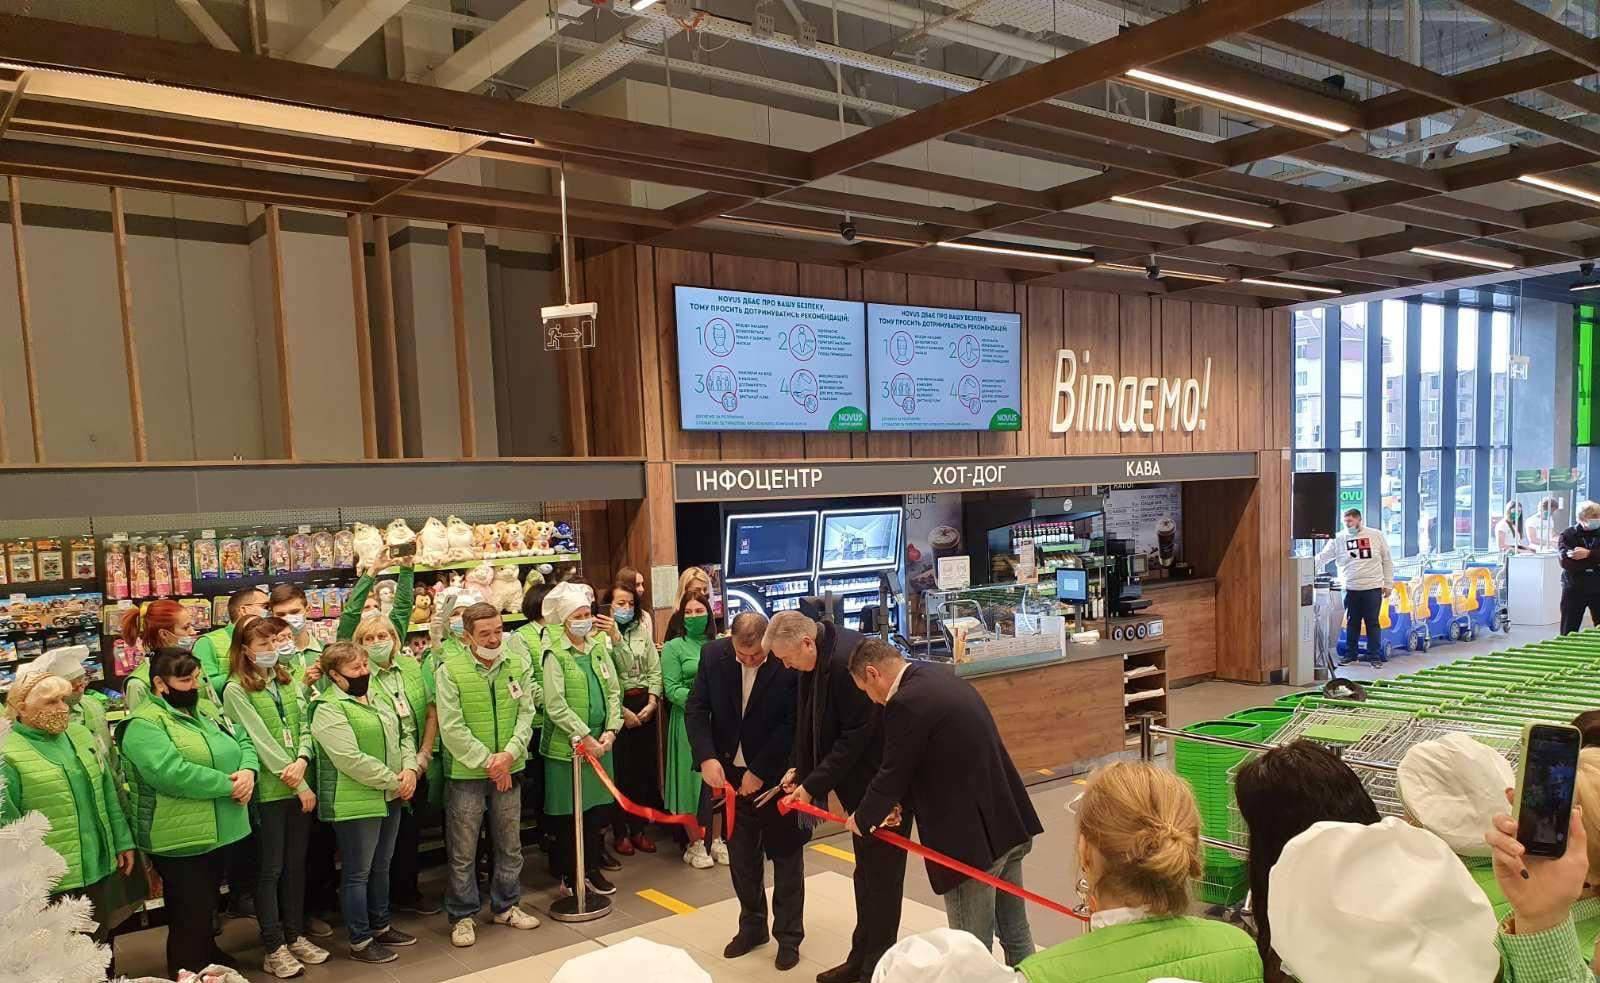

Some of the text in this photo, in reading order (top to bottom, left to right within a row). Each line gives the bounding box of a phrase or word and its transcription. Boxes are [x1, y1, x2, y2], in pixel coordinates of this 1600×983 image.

[690, 303, 710, 312] ТОМУ
[711, 304, 743, 314] ПРОСИТЬ
[744, 307, 800, 318] ДОТРИМУВАТИСЬ
[718, 295, 741, 304] NOVUS
[762, 299, 776, 307] ПРО
[777, 300, 796, 309] ВАШУ
[879, 317, 896, 325] ТОМУ
[896, 318, 922, 327] ПРОСИТЬ
[695, 326, 704, 345] 1
[778, 331, 788, 351] 2
[882, 338, 889, 354] 1
[949, 341, 957, 359] 2
[695, 374, 705, 394] 3
[779, 377, 790, 397] 4
[881, 381, 890, 399] 3
[949, 382, 958, 400] 4
[1049, 348, 1211, 433] Вітаємо!
[838, 412, 863, 421] NOVUS
[933, 465, 1007, 485] ХОТ-ДОГ
[1126, 460, 1161, 477] КАВА
[696, 467, 823, 491] ІНФОЦЕНТР
[905, 494, 937, 505] ЕНЬКЕ
[1341, 491, 1362, 501] OVU
